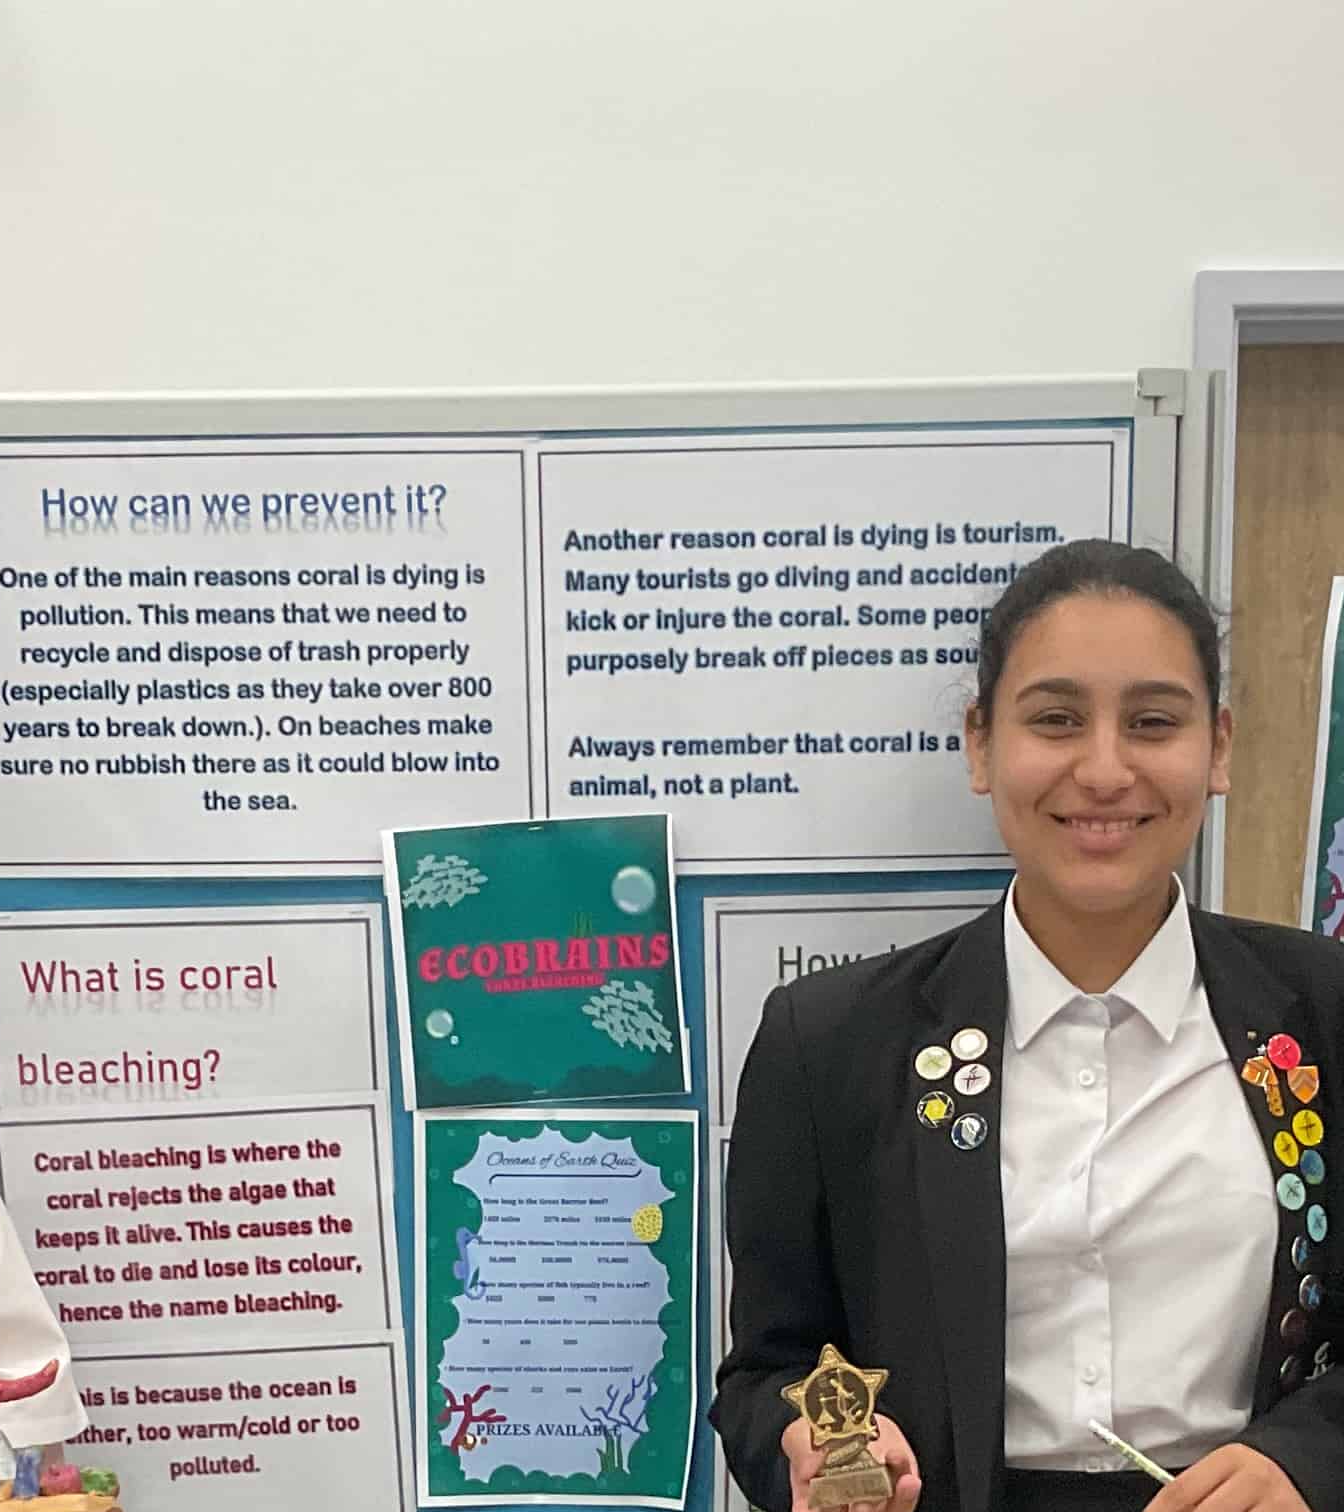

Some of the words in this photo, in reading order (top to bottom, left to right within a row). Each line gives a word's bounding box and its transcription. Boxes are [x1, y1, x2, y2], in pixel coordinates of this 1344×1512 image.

[42, 487, 117, 518] How
[128, 493, 191, 516] can
[201, 492, 250, 514] we
[262, 485, 396, 521] prevent
[406, 484, 447, 514] it?
[563, 528, 665, 553] Another
[669, 531, 756, 550] reason
[762, 524, 827, 548] coral
[833, 523, 854, 547] is
[860, 523, 929, 552] dying
[935, 522, 957, 545] is
[962, 520, 1065, 545] tourism.
[53, 566, 80, 589] of
[83, 566, 123, 588] the
[128, 565, 187, 588] main
[193, 569, 291, 588] reasons
[297, 563, 360, 586] coral
[366, 563, 386, 586] is
[392, 563, 459, 591] dying
[465, 563, 486, 585] is
[565, 569, 631, 597] Many
[635, 567, 732, 591] tourists
[736, 571, 769, 594] go
[774, 564, 850, 592] diving
[856, 563, 903, 587] and
[909, 562, 1009, 586] accident
[20, 604, 132, 632] pollution.
[137, 603, 190, 625] This
[195, 607, 276, 625] means
[281, 602, 331, 625] that
[334, 607, 371, 624] we
[376, 601, 437, 624] need
[442, 601, 468, 623] to
[20, 641, 110, 669] recycle
[116, 640, 161, 663] and
[167, 640, 262, 668] dispose
[268, 640, 294, 662] of
[297, 639, 361, 662] trash
[367, 639, 470, 667] properly
[569, 773, 657, 800] animal,
[663, 773, 705, 796] not
[708, 778, 724, 795] a
[730, 772, 799, 800] plant.
[419, 932, 670, 982] ECOBRAINS
[20, 960, 119, 993] What
[134, 959, 165, 991] is
[180, 956, 277, 990] coral
[17, 1049, 221, 1090] bleaching?
[34, 1149, 94, 1173] Coral
[97, 1145, 202, 1171] bleaching
[206, 1144, 227, 1165] is
[231, 1141, 301, 1164] where
[306, 1138, 342, 1160] the
[540, 1152, 552, 1169] of
[46, 1187, 104, 1211] coral
[107, 1185, 183, 1212] rejects
[187, 1182, 223, 1204] the
[228, 1180, 288, 1206] algae
[292, 1177, 337, 1199] that
[477, 1424, 531, 1437] PRIZES
